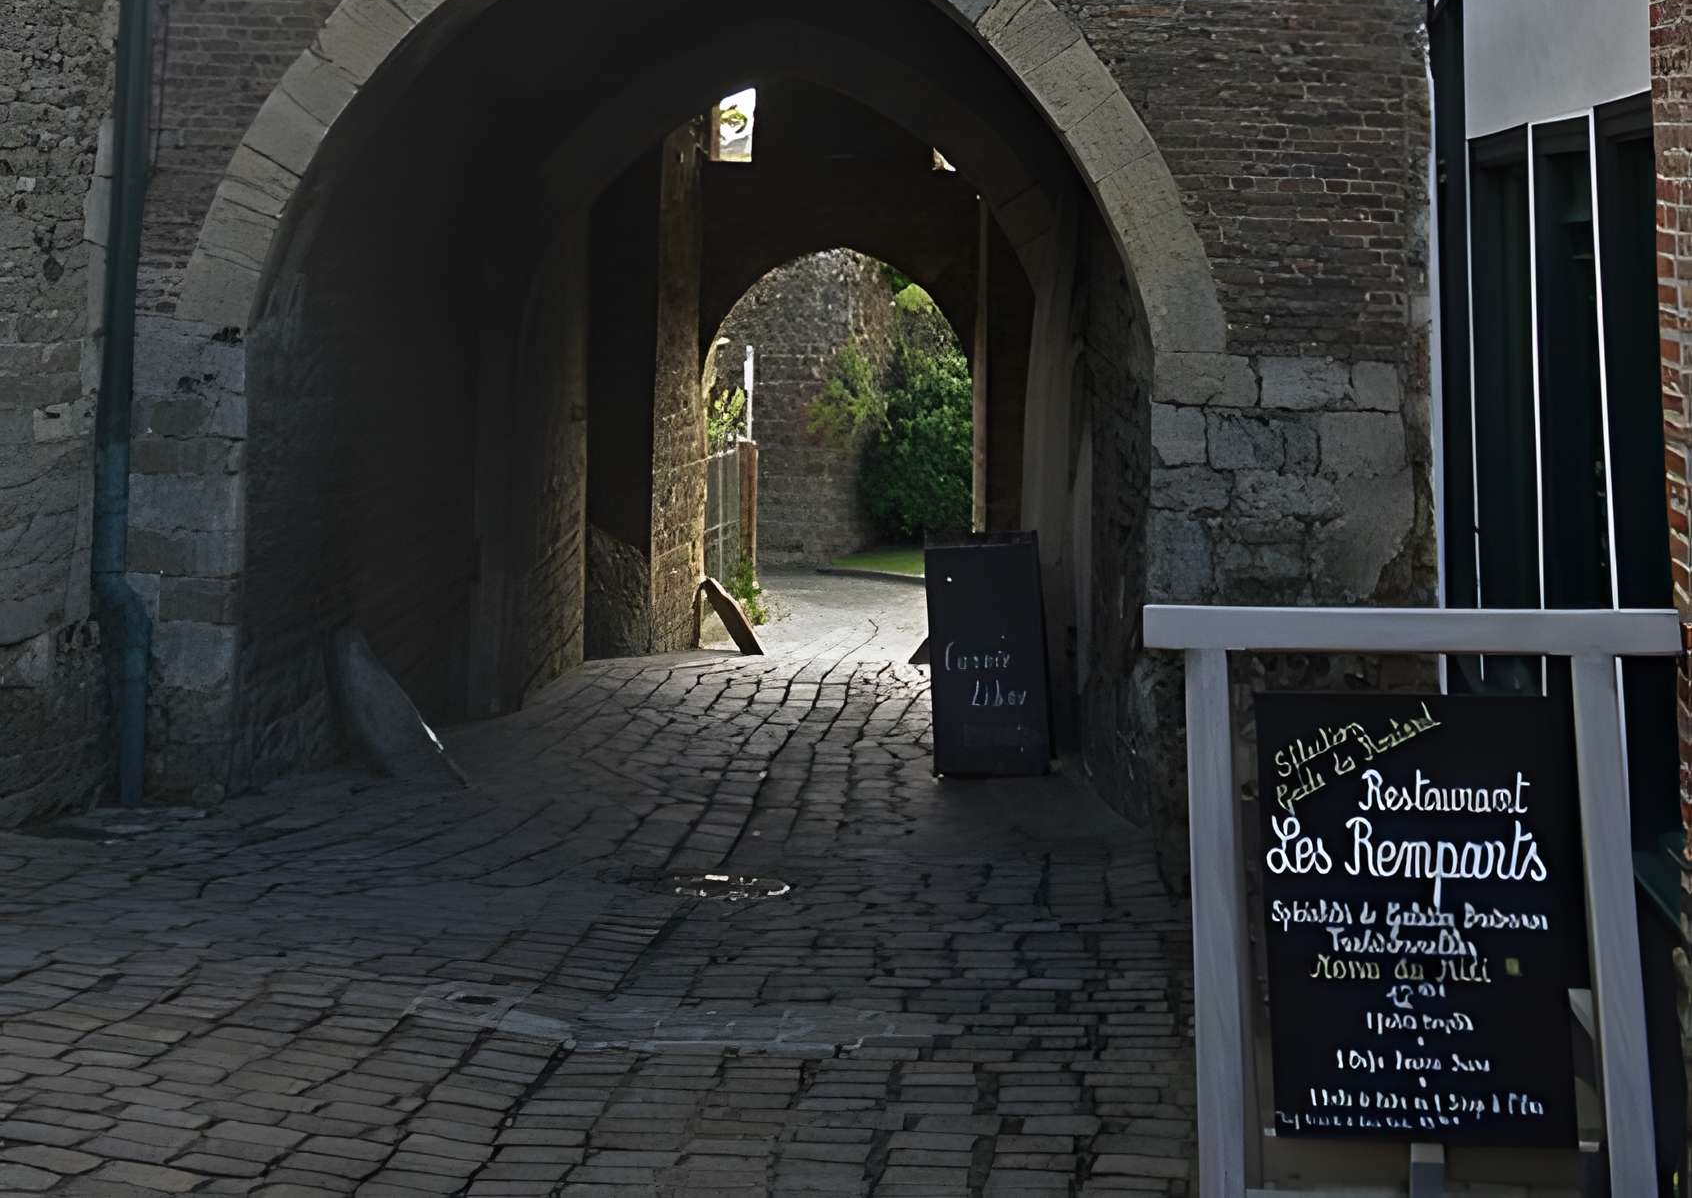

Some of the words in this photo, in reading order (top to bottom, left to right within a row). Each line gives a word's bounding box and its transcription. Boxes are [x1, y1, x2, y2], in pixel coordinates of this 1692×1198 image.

[1358, 769, 1531, 813] Restaurant
[1266, 815, 1332, 875] Les
[1344, 816, 1547, 907] Remparts
